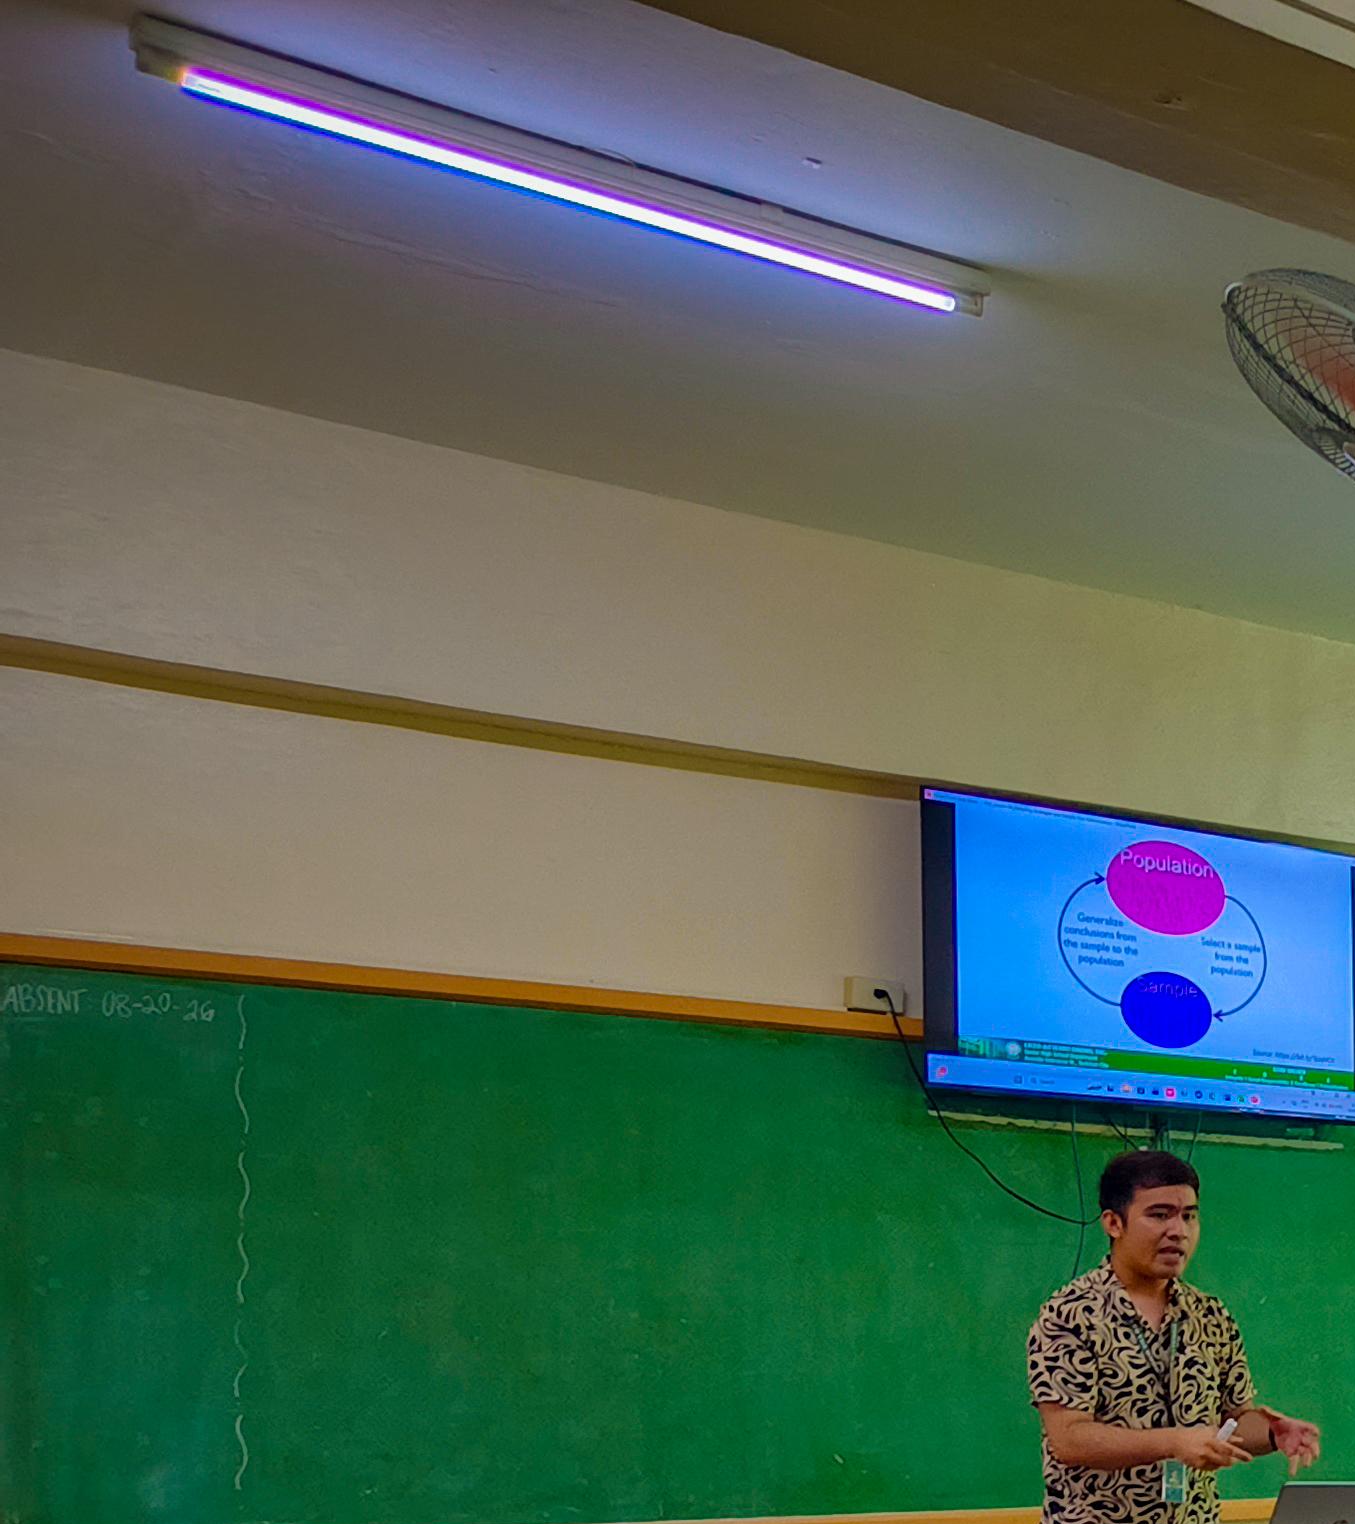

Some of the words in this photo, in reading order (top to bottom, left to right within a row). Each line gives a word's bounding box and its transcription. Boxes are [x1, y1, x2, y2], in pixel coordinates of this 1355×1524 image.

[1119, 849, 1214, 879] Population
[1078, 955, 1124, 967] population
[1210, 965, 1253, 977] population
[0, 983, 88, 1014] ABSENT
[1136, 976, 1199, 999] Sample
